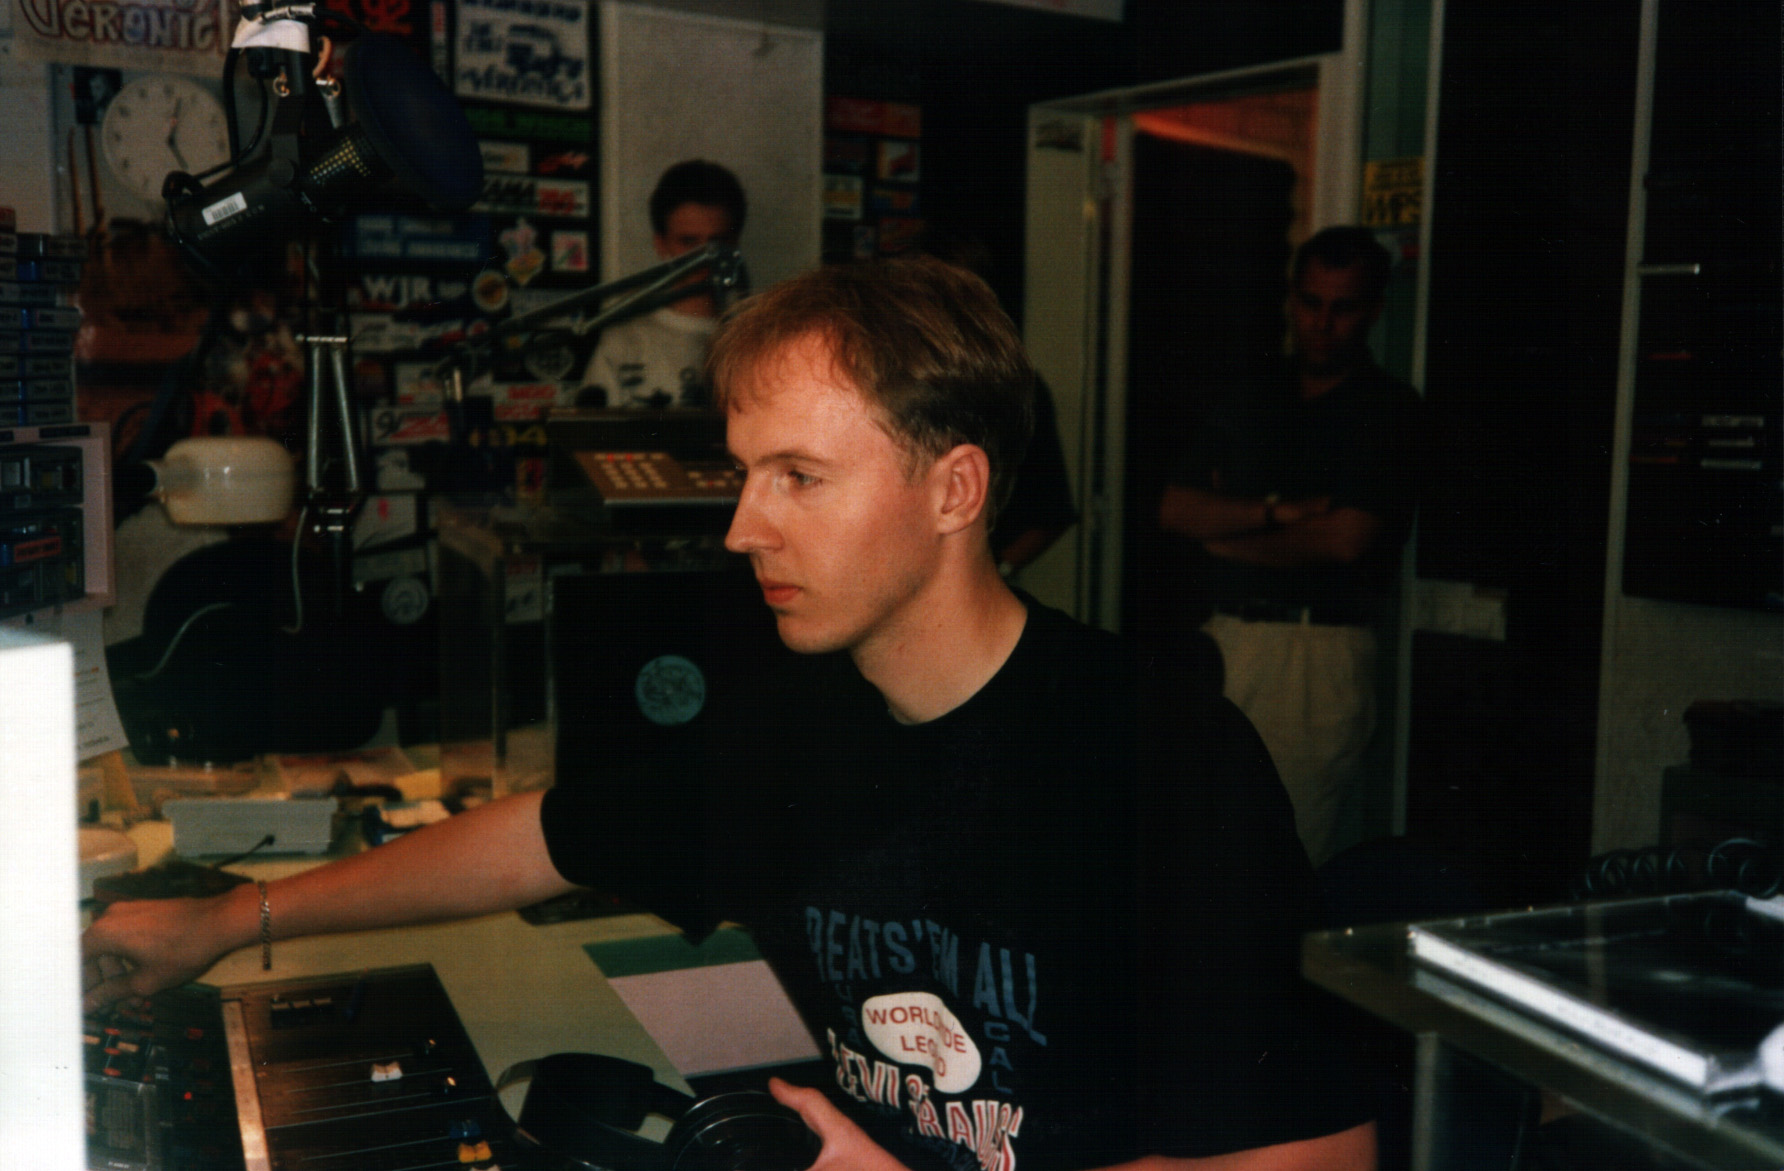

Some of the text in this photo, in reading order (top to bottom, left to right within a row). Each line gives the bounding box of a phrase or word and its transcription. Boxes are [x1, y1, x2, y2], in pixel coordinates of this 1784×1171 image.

[973, 941, 1047, 1047] ALL
[866, 1005, 967, 1054] WORLDE
[900, 1034, 947, 1077] LED
